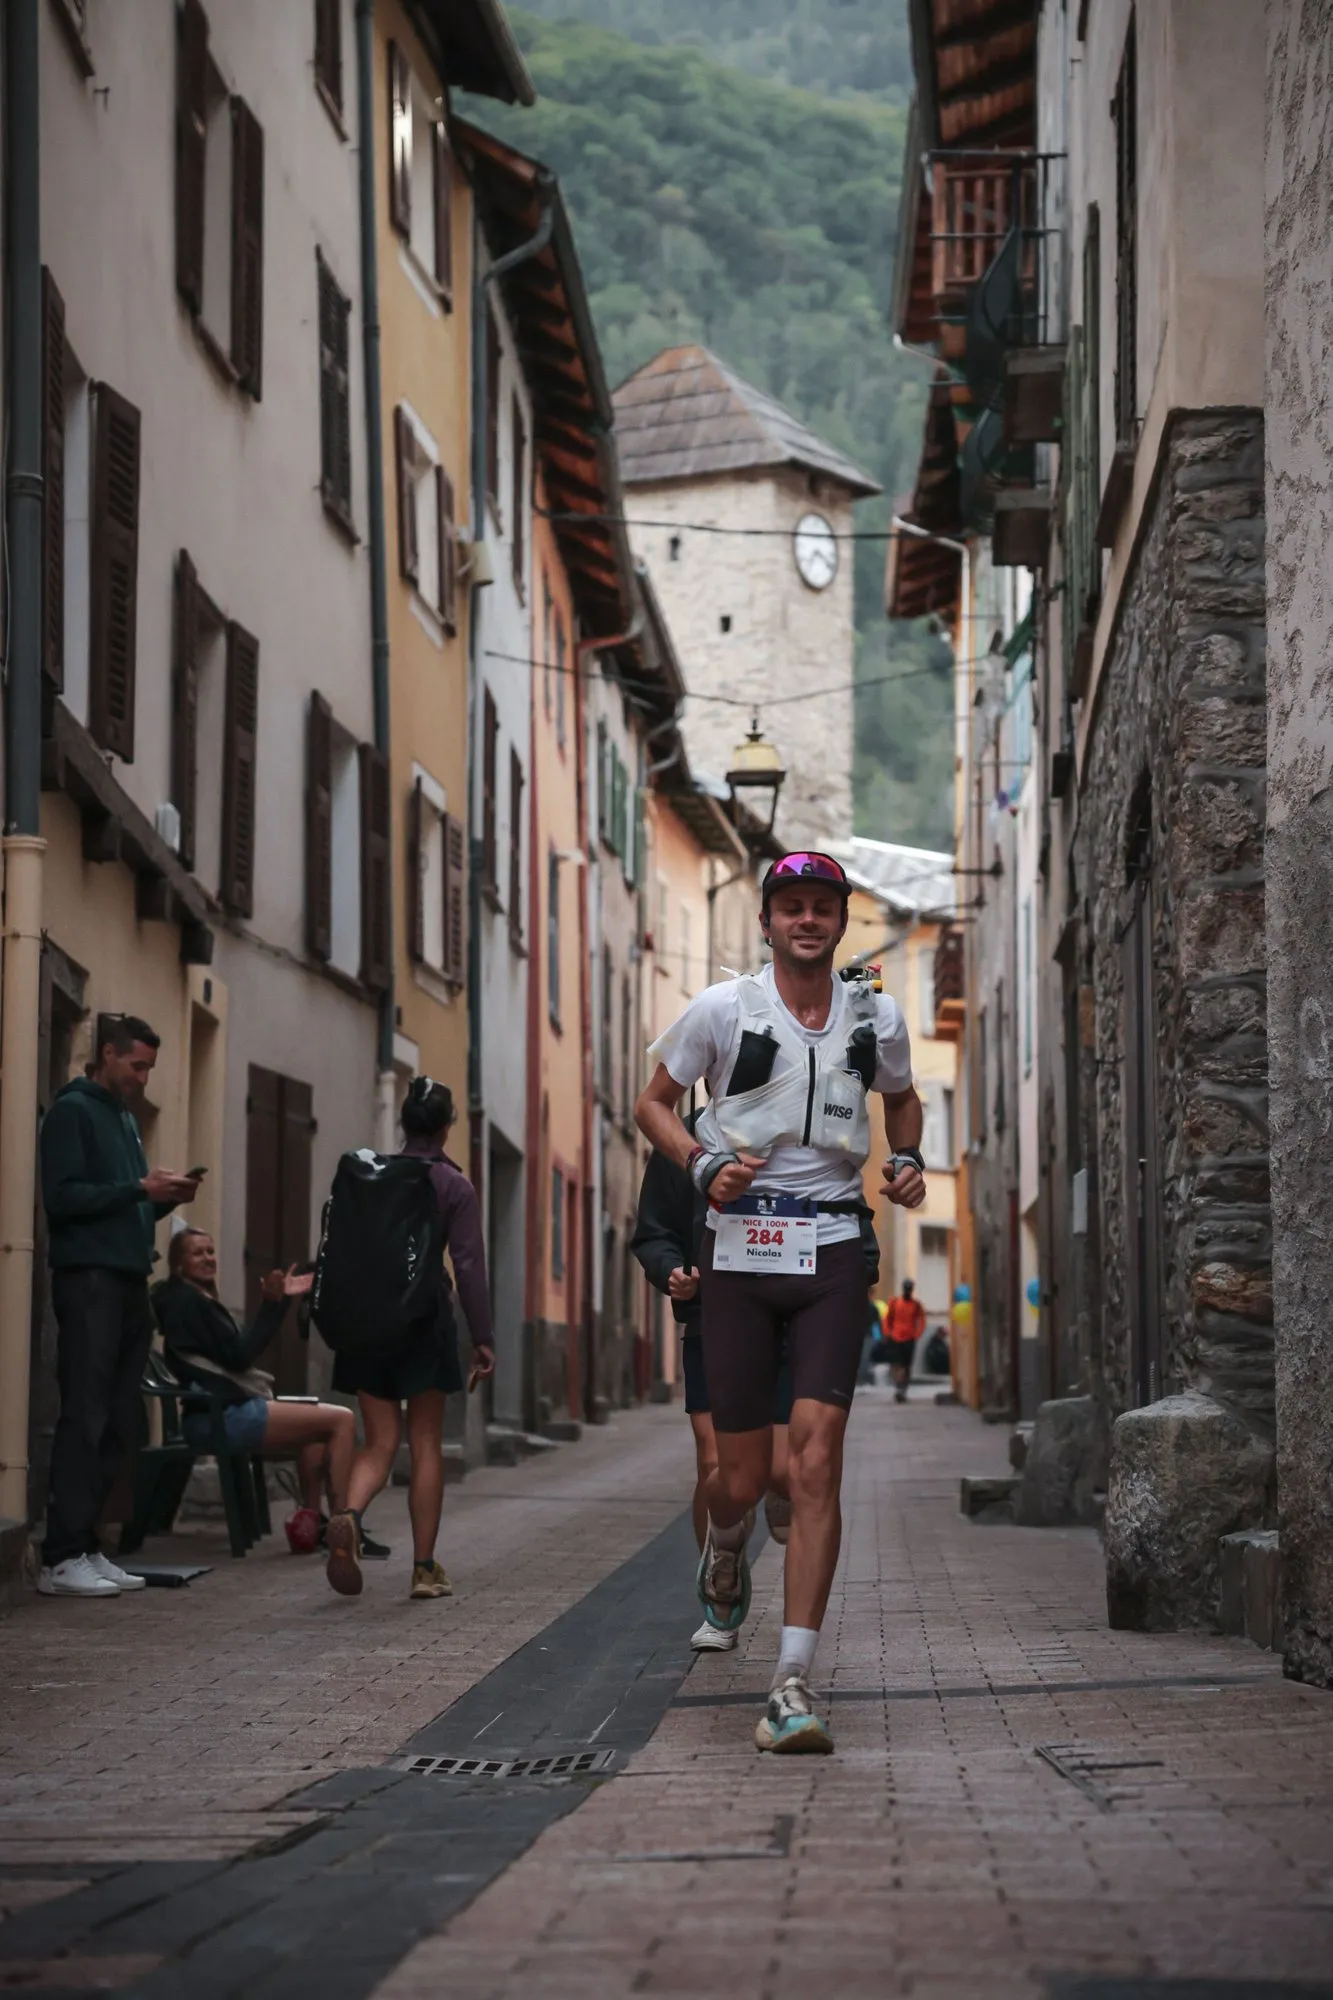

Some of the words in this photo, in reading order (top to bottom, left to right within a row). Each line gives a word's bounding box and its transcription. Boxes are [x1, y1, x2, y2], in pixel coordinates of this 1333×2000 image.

[742, 1219, 762, 1227] NICE
[766, 1220, 789, 1228] 100M
[746, 1228, 784, 1246] 284
[746, 1248, 782, 1258] Nicolas
